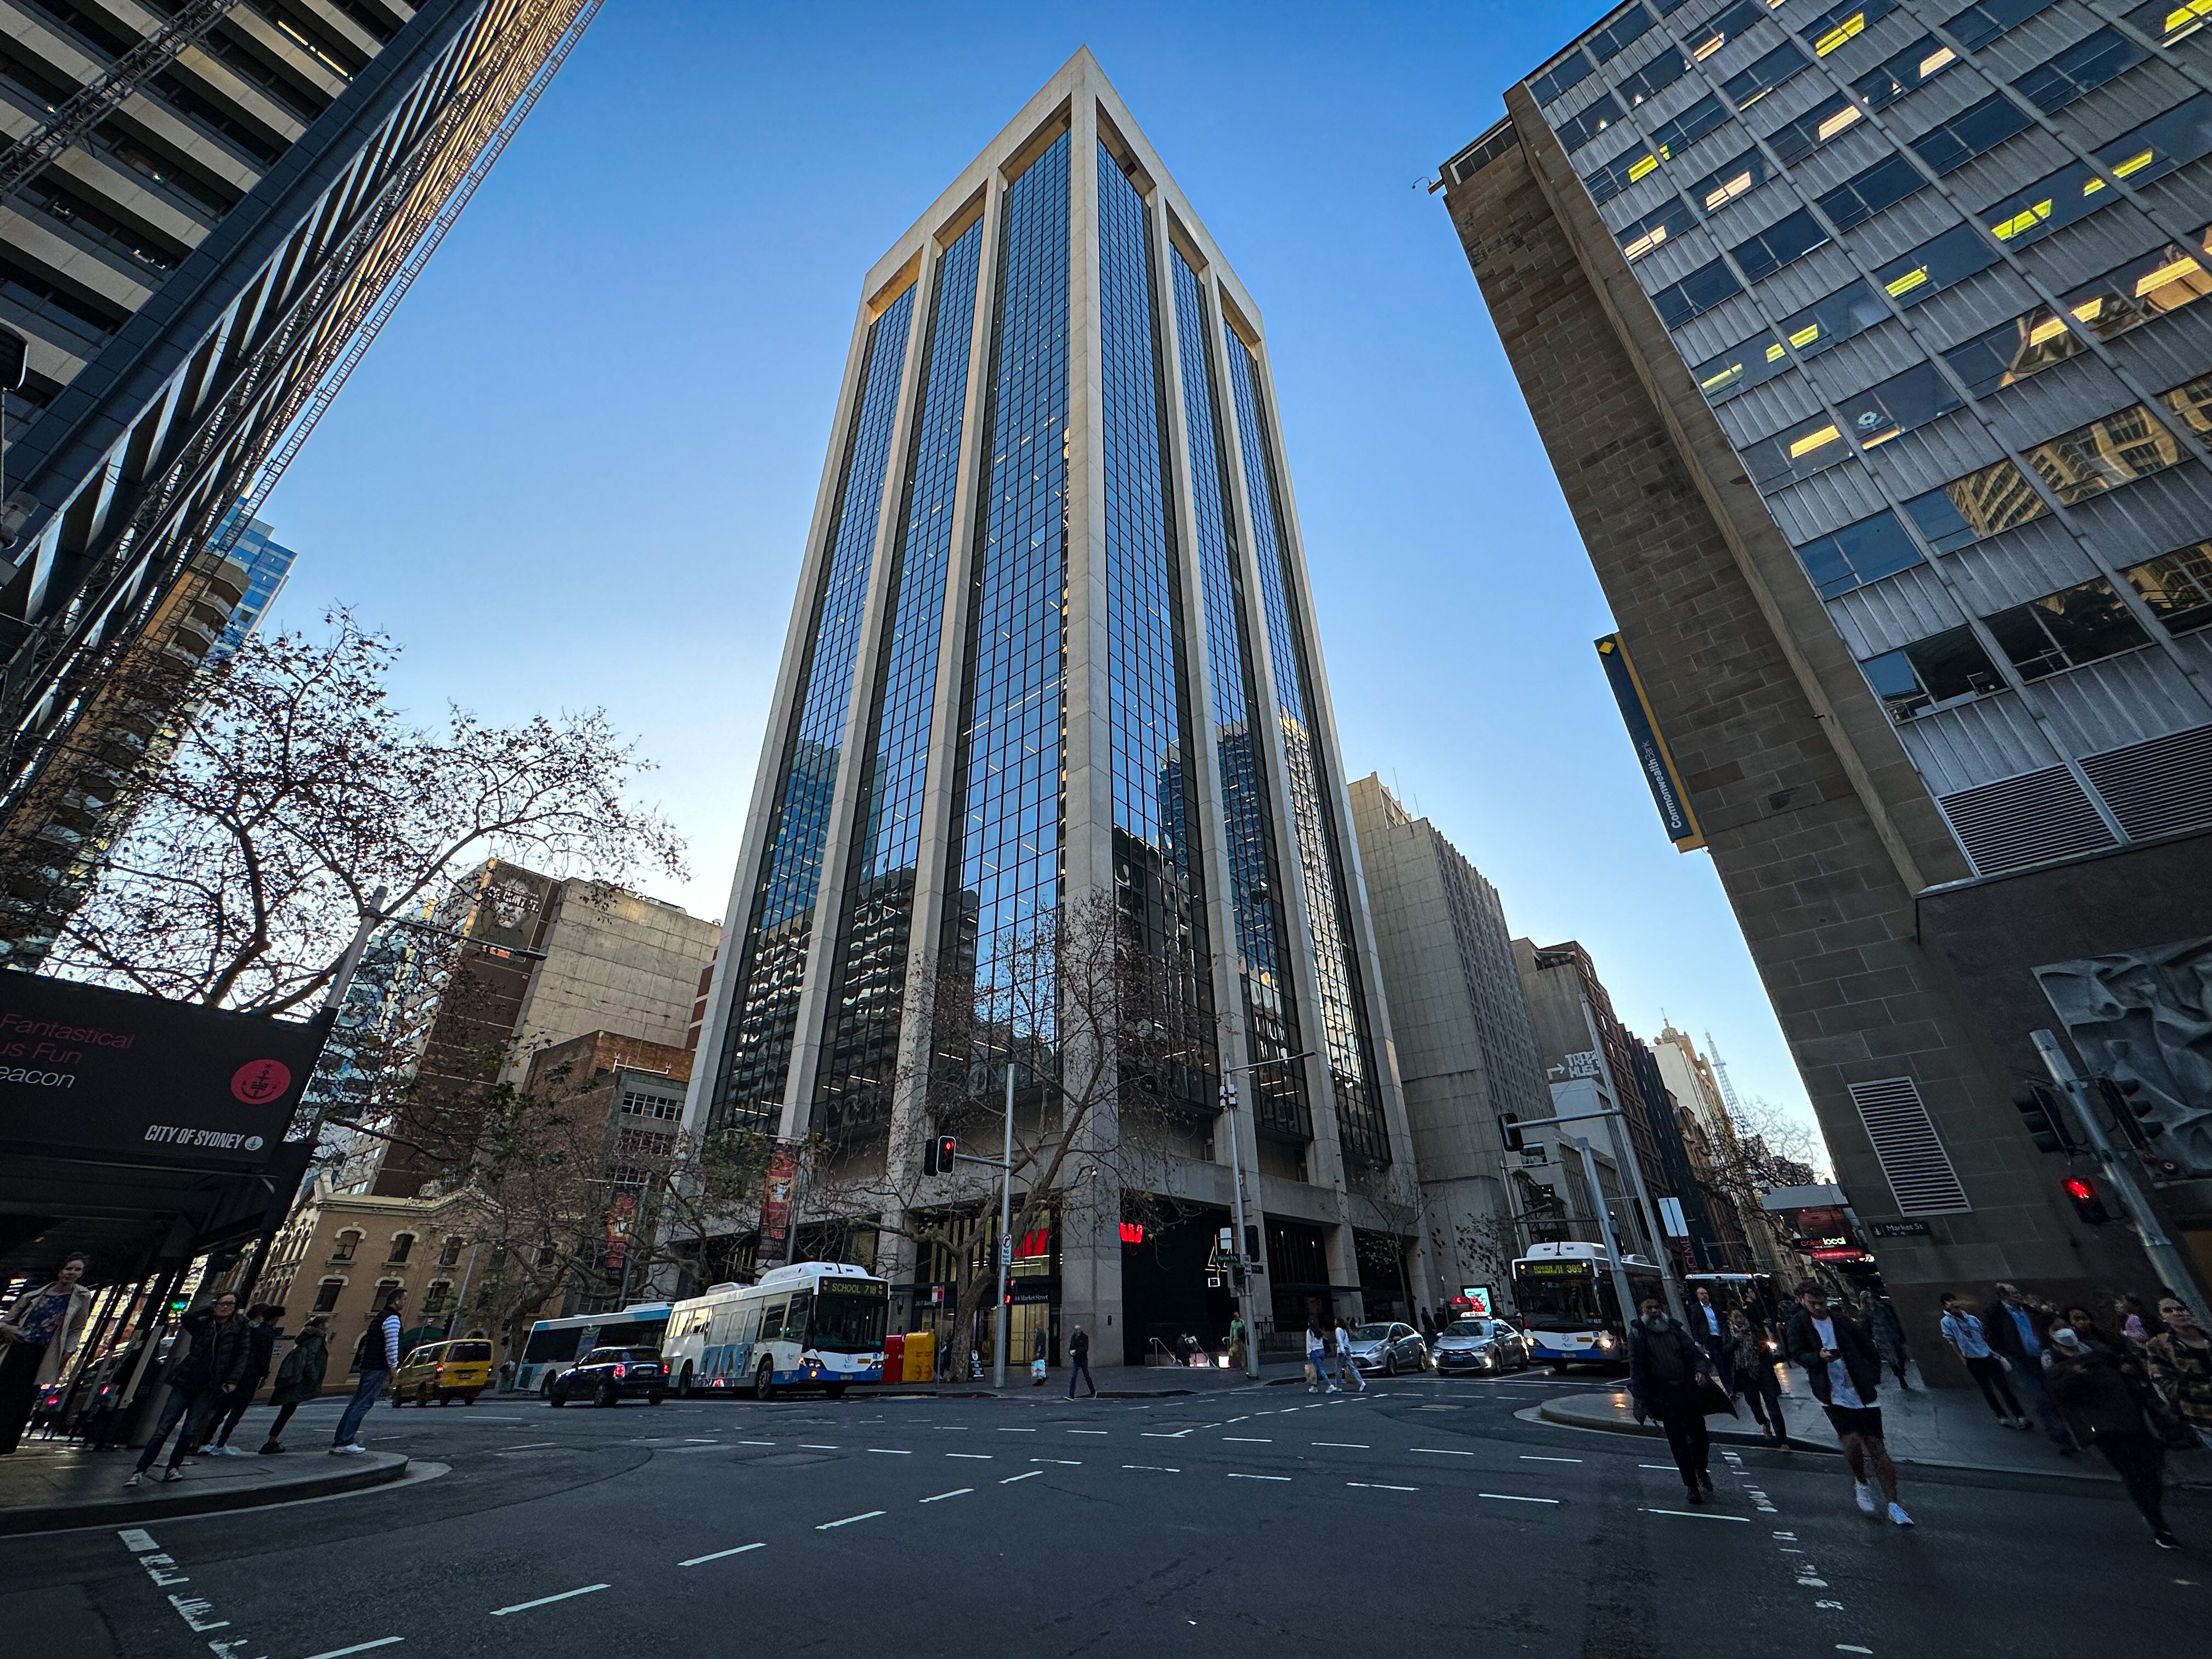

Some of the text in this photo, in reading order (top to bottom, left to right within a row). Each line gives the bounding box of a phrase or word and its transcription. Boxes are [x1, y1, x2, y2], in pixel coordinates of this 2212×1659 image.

[1641, 740, 1682, 829] CommonwealthBank
[0, 1013, 136, 1048] Fantastical
[32, 1042, 83, 1065] Fun
[144, 1125, 245, 1149] CITY OF SYDNEY
[1566, 1264, 1582, 1273] 389
[832, 1282, 877, 1295] SCHOOL 718
